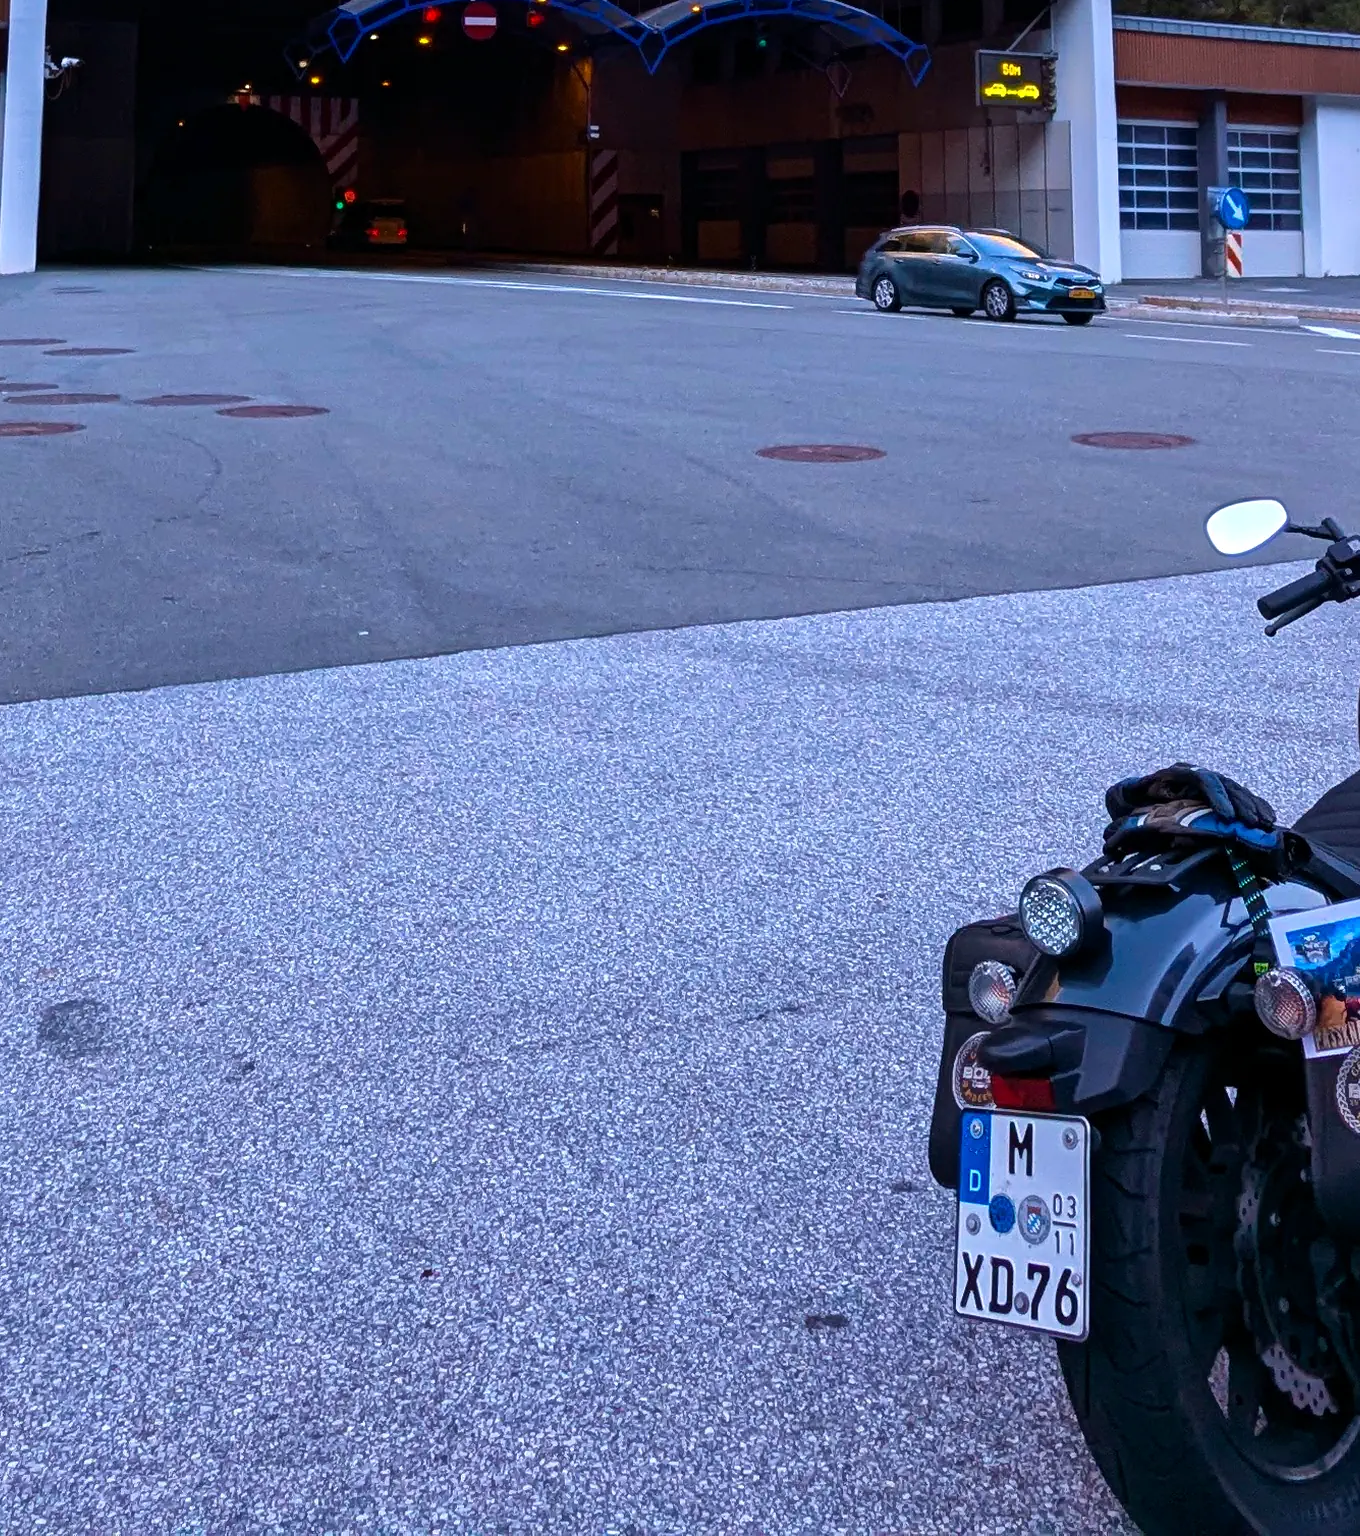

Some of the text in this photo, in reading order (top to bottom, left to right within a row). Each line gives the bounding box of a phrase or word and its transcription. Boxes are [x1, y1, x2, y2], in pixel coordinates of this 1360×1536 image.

[1008, 1121, 1034, 1177] M
[969, 1168, 982, 1192] D
[1052, 1193, 1077, 1219] 03
[1053, 1231, 1076, 1256] 11
